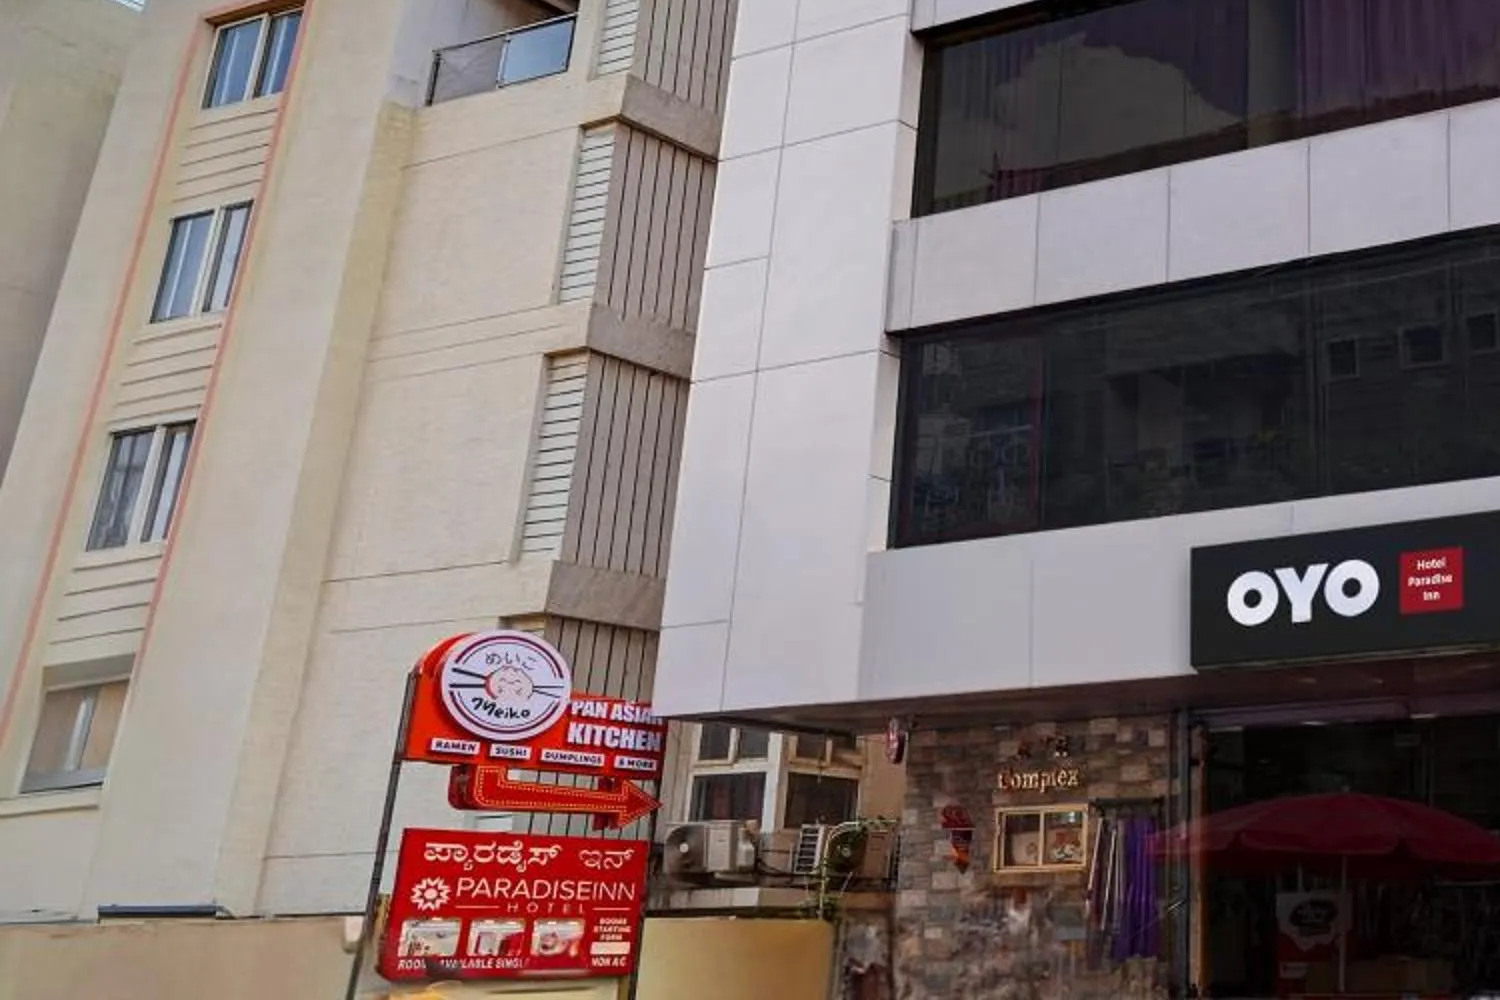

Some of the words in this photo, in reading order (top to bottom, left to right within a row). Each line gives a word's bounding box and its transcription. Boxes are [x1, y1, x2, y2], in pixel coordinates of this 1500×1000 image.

[1417, 556, 1446, 570] Hotel
[1227, 559, 1380, 626] OYO
[1423, 591, 1441, 601] Inn
[485, 652, 537, 671] めいこ
[471, 697, 530, 719] Meiko
[571, 700, 608, 719] PAN
[567, 721, 662, 751] KITCHEN
[436, 740, 477, 753] RAMEN
[495, 746, 527, 757] SUSHI
[545, 751, 602, 765] DUMPLINGS
[627, 759, 655, 769] MORE
[507, 902, 586, 914] HOTEL
